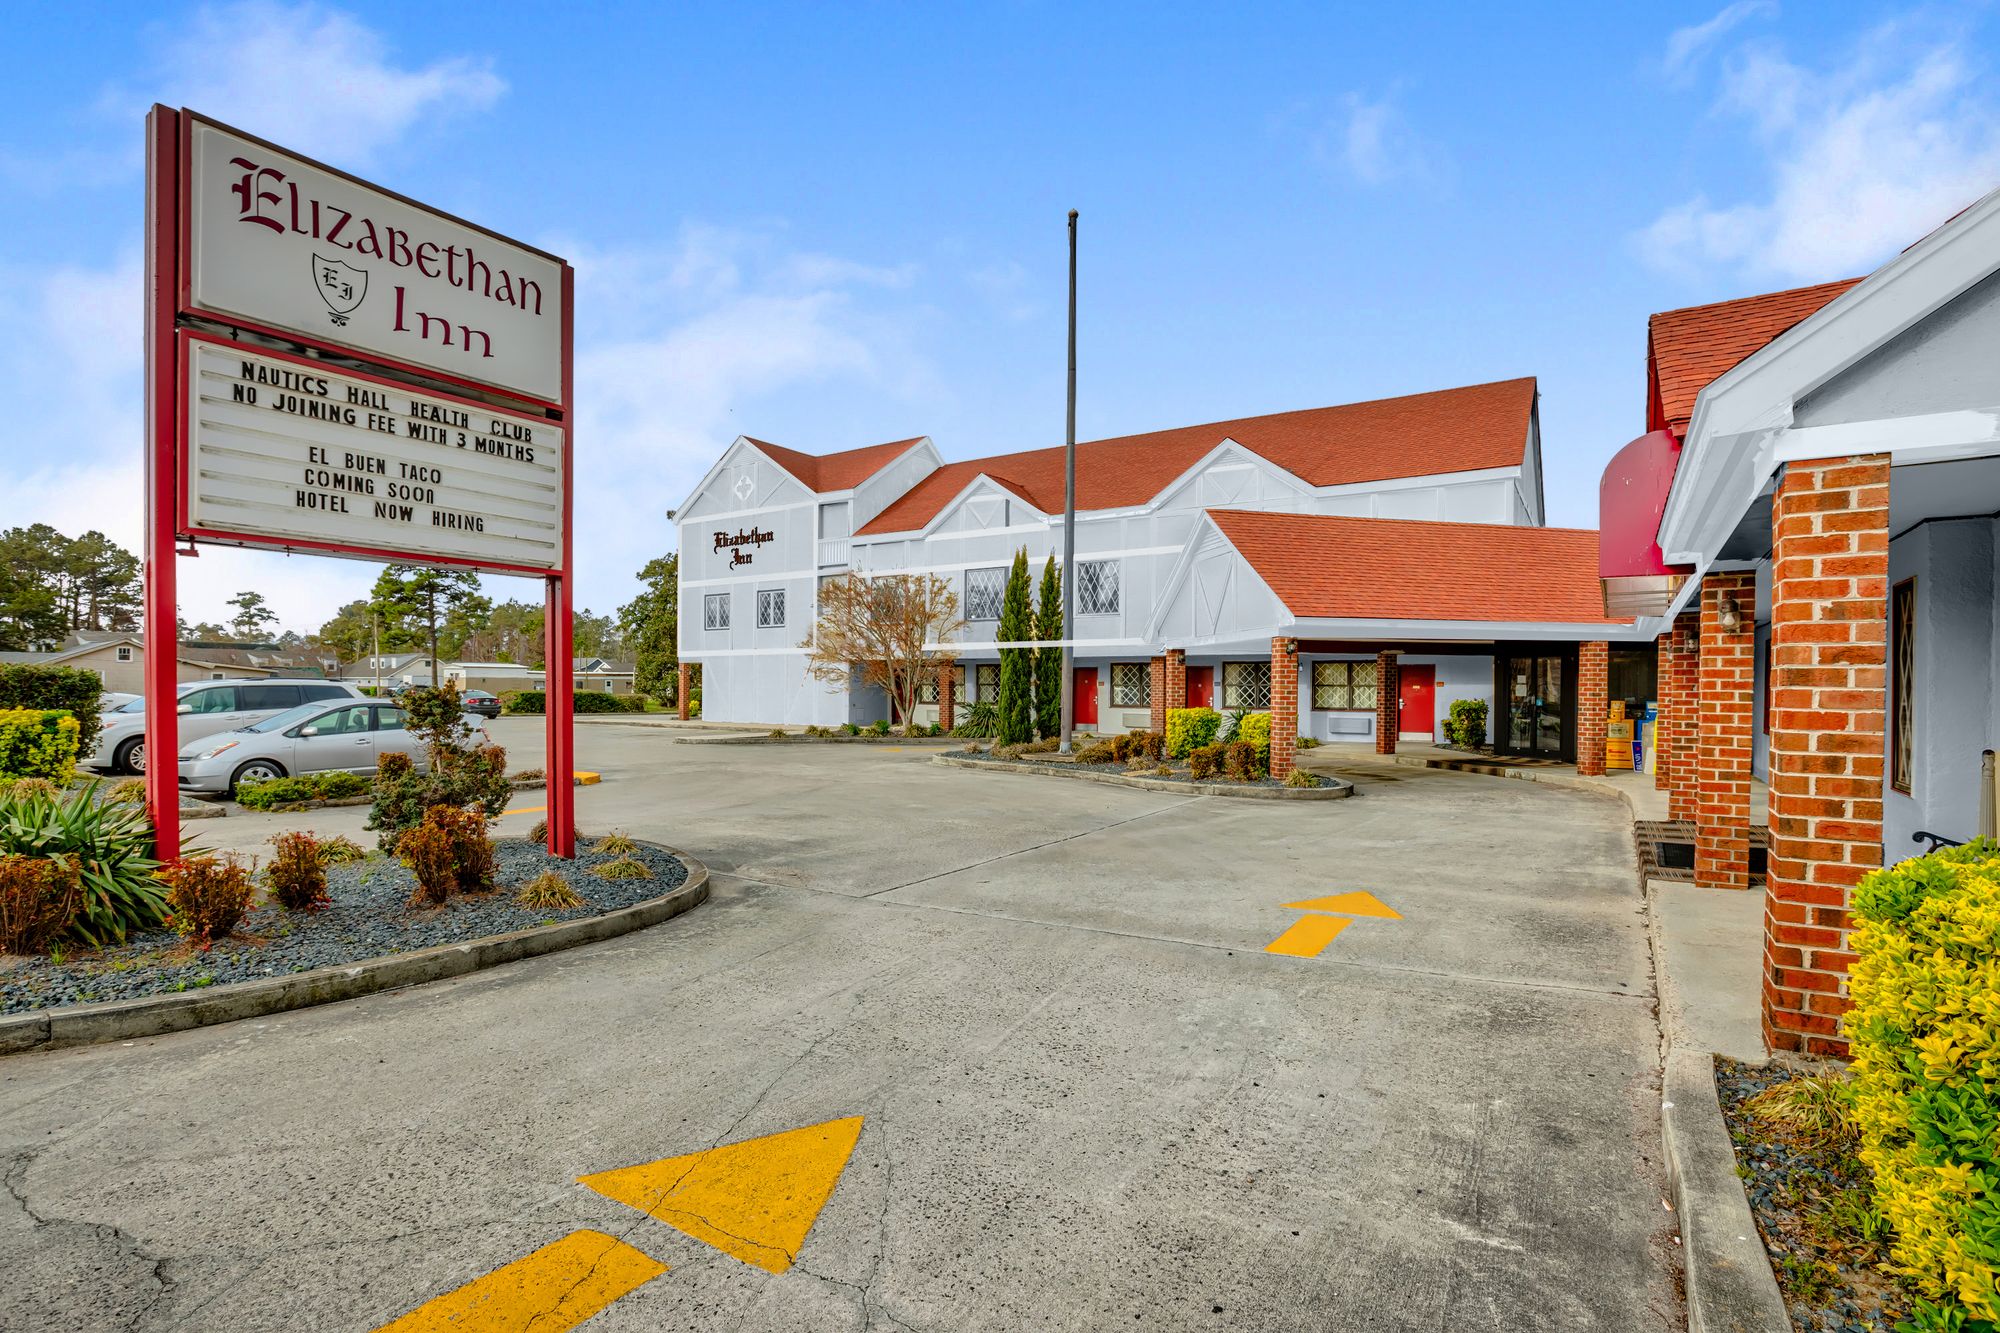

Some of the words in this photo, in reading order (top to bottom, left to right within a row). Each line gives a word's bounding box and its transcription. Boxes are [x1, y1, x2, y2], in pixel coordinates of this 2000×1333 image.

[229, 157, 541, 315] Elizabethan
[393, 286, 494, 358] Inn
[242, 361, 328, 396] NAUTICS
[347, 386, 389, 411] HALL
[410, 401, 468, 428] HEALTH
[491, 420, 532, 443] CLUB
[233, 384, 256, 405] NO
[272, 394, 355, 426] JOINING
[368, 413, 395, 434] FEE
[408, 422, 446, 446] WITH
[457, 433, 467, 448] 3
[475, 436, 534, 463] MONTHS
[305, 469, 374, 495] COMING
[309, 447, 329, 466] EL
[345, 452, 385, 475] BUEN
[400, 462, 441, 484] TACO
[296, 490, 349, 513] HOTEL
[375, 502, 413, 522] NOW
[433, 510, 484, 532] HIRING
[713, 526, 774, 554] Elizabethan
[729, 547, 752, 571] Inn
